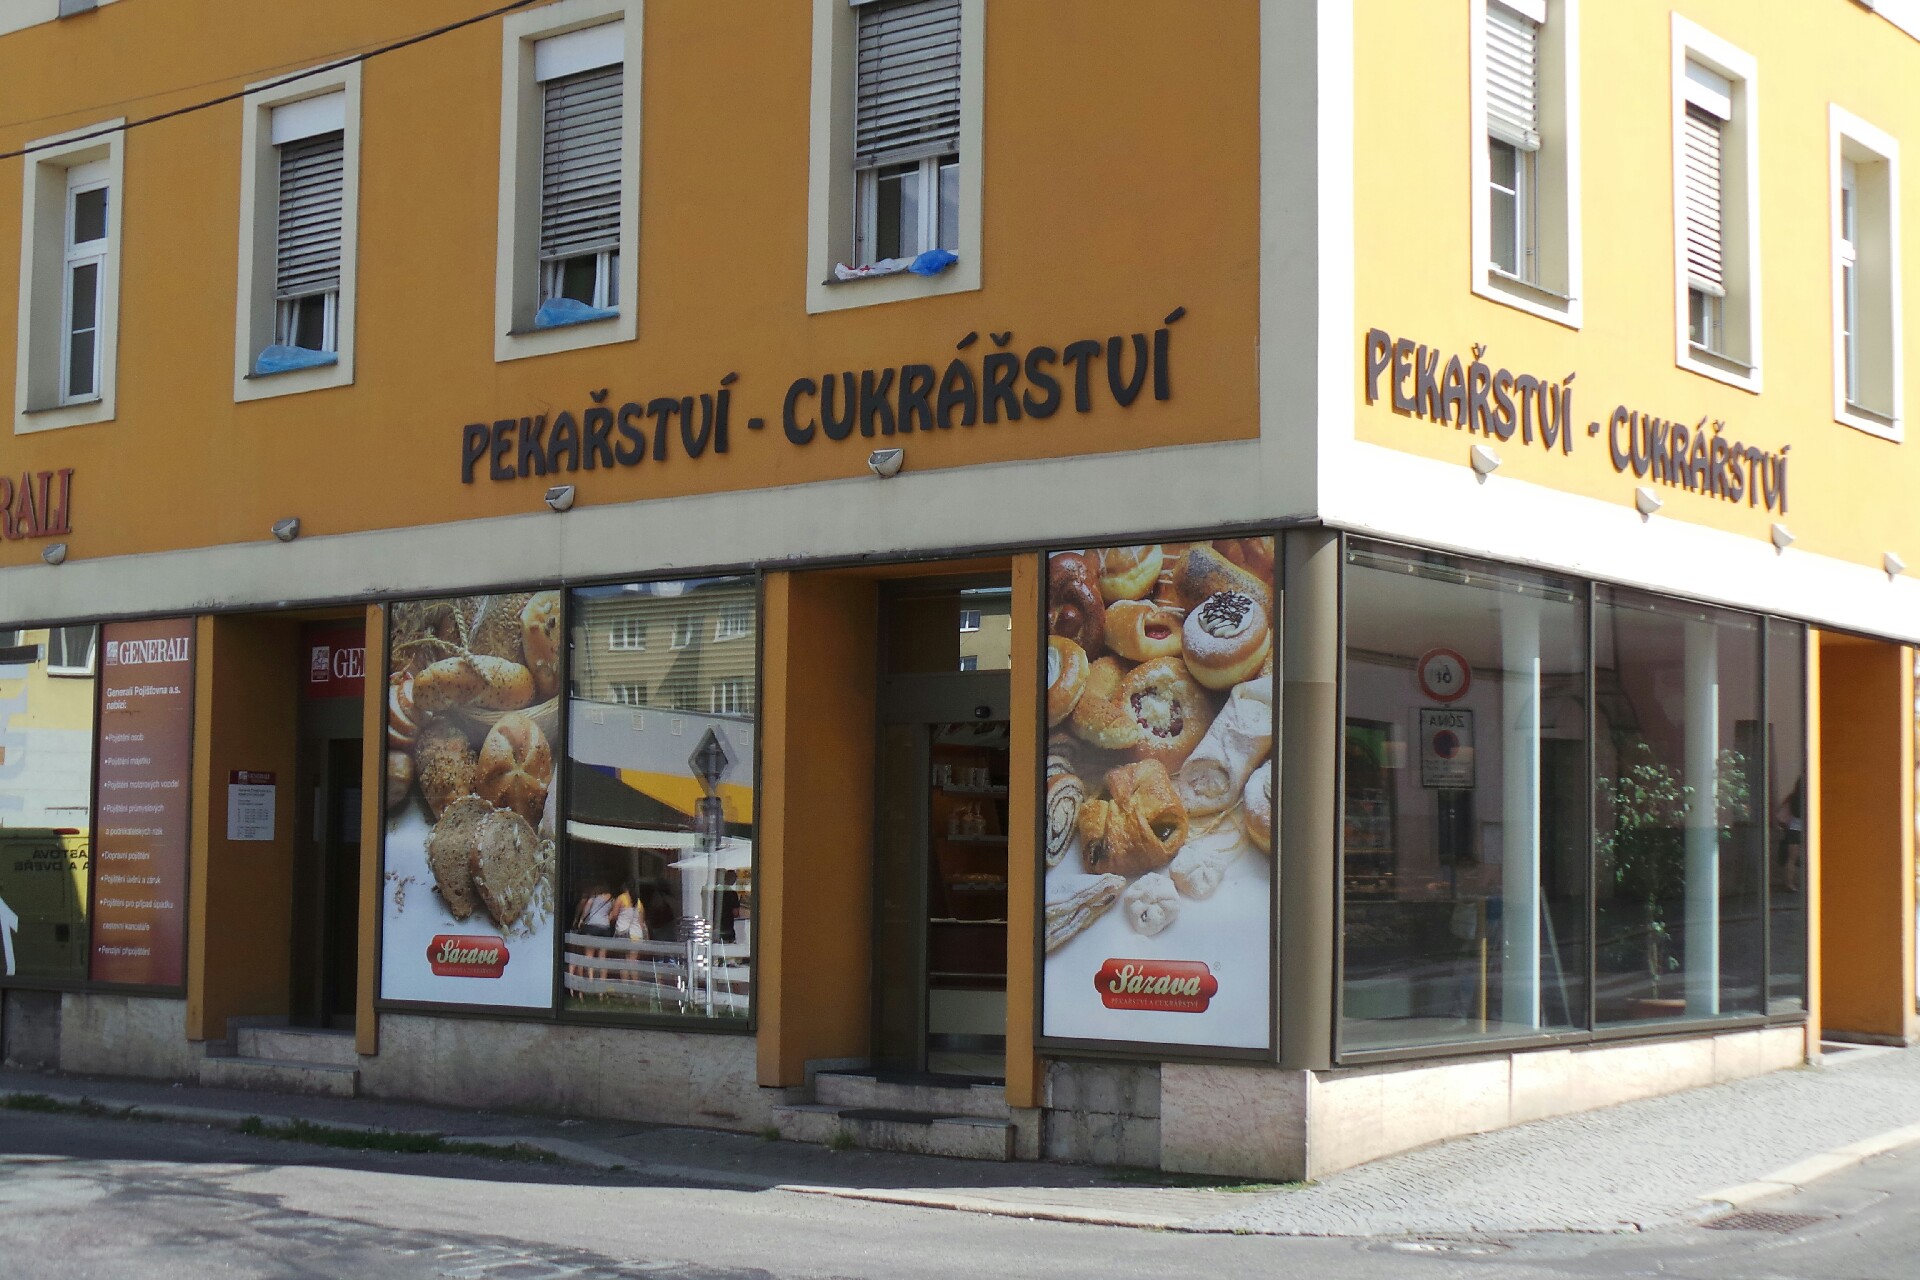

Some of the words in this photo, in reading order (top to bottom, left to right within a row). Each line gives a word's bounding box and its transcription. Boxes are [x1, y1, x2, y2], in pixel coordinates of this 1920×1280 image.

[461, 371, 738, 484] PEKAŘSTVÍ
[782, 306, 1187, 444] CUKRÁŘSTVÍ
[1365, 328, 1577, 455] PEKAŘSTVÍ
[1610, 404, 1791, 515] CUKRÁŘSTVÍ
[119, 637, 189, 666] GENERALI
[436, 939, 499, 965] Sázava
[1109, 964, 1201, 996] Sázava
